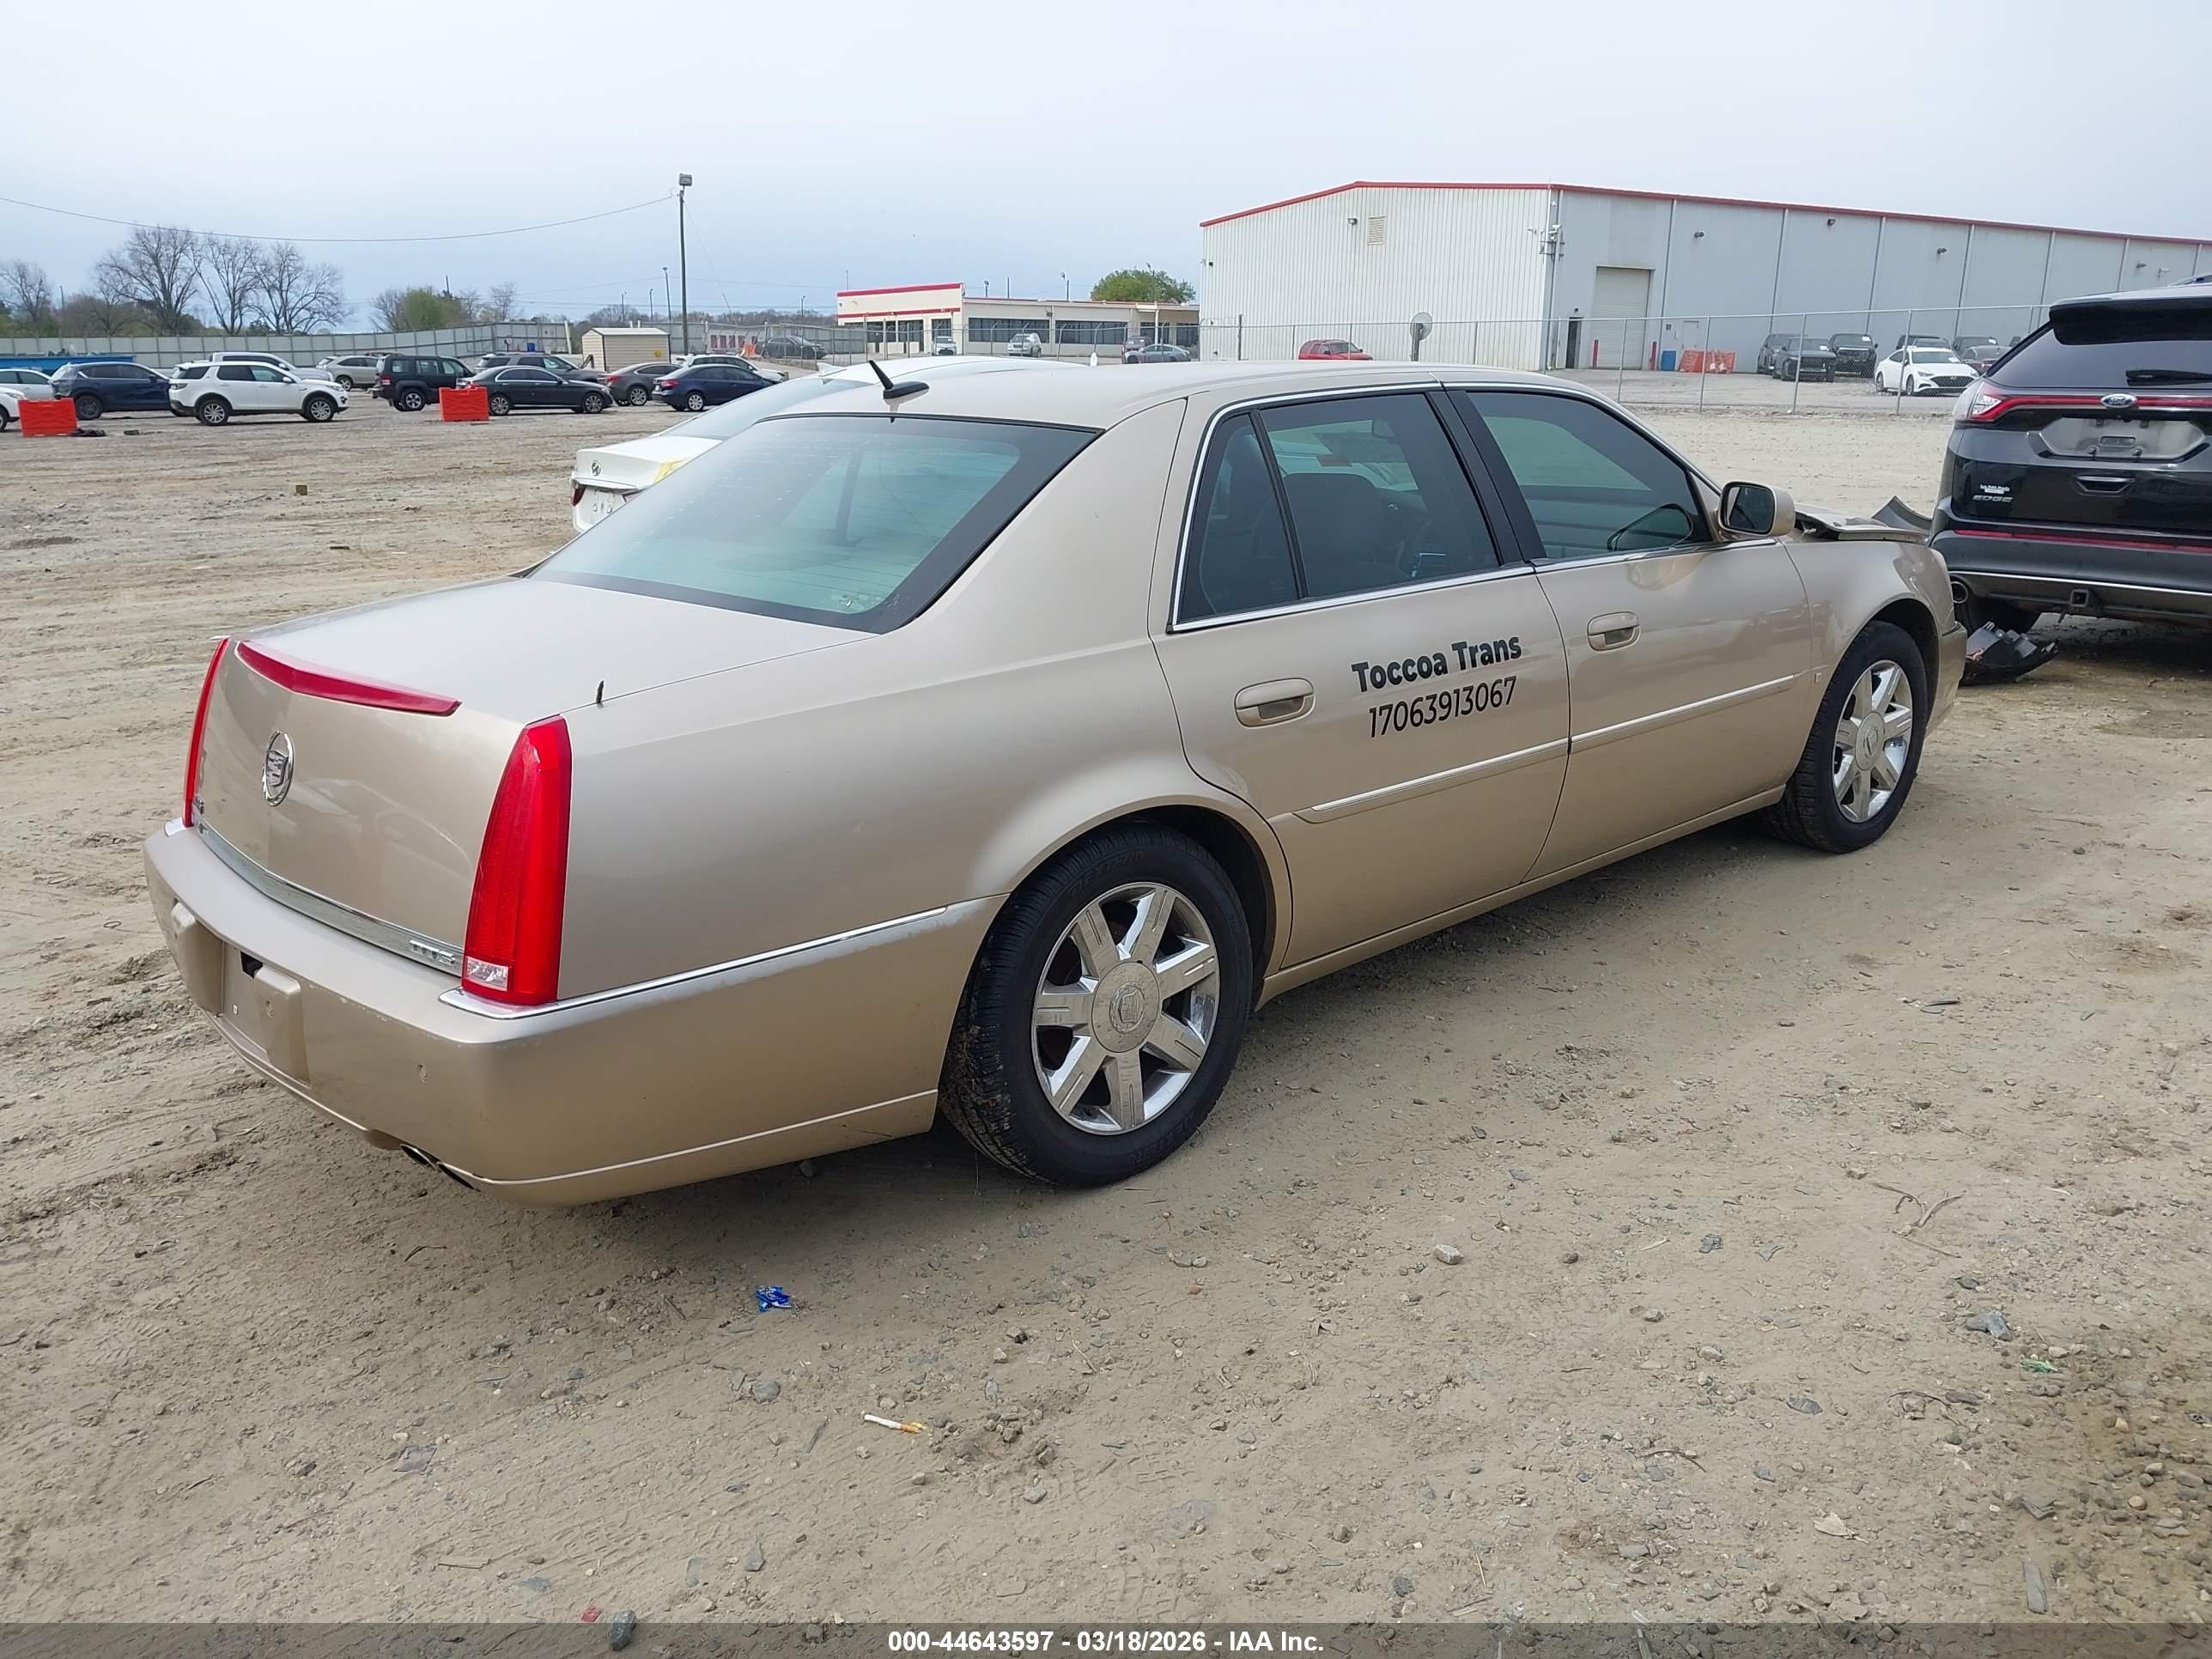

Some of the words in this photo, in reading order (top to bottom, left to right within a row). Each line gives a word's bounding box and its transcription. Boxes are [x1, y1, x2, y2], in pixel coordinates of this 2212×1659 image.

[1351, 652, 1449, 693] Toccoa
[1451, 636, 1522, 672] Trans
[1369, 675, 1517, 738] 17063913067
